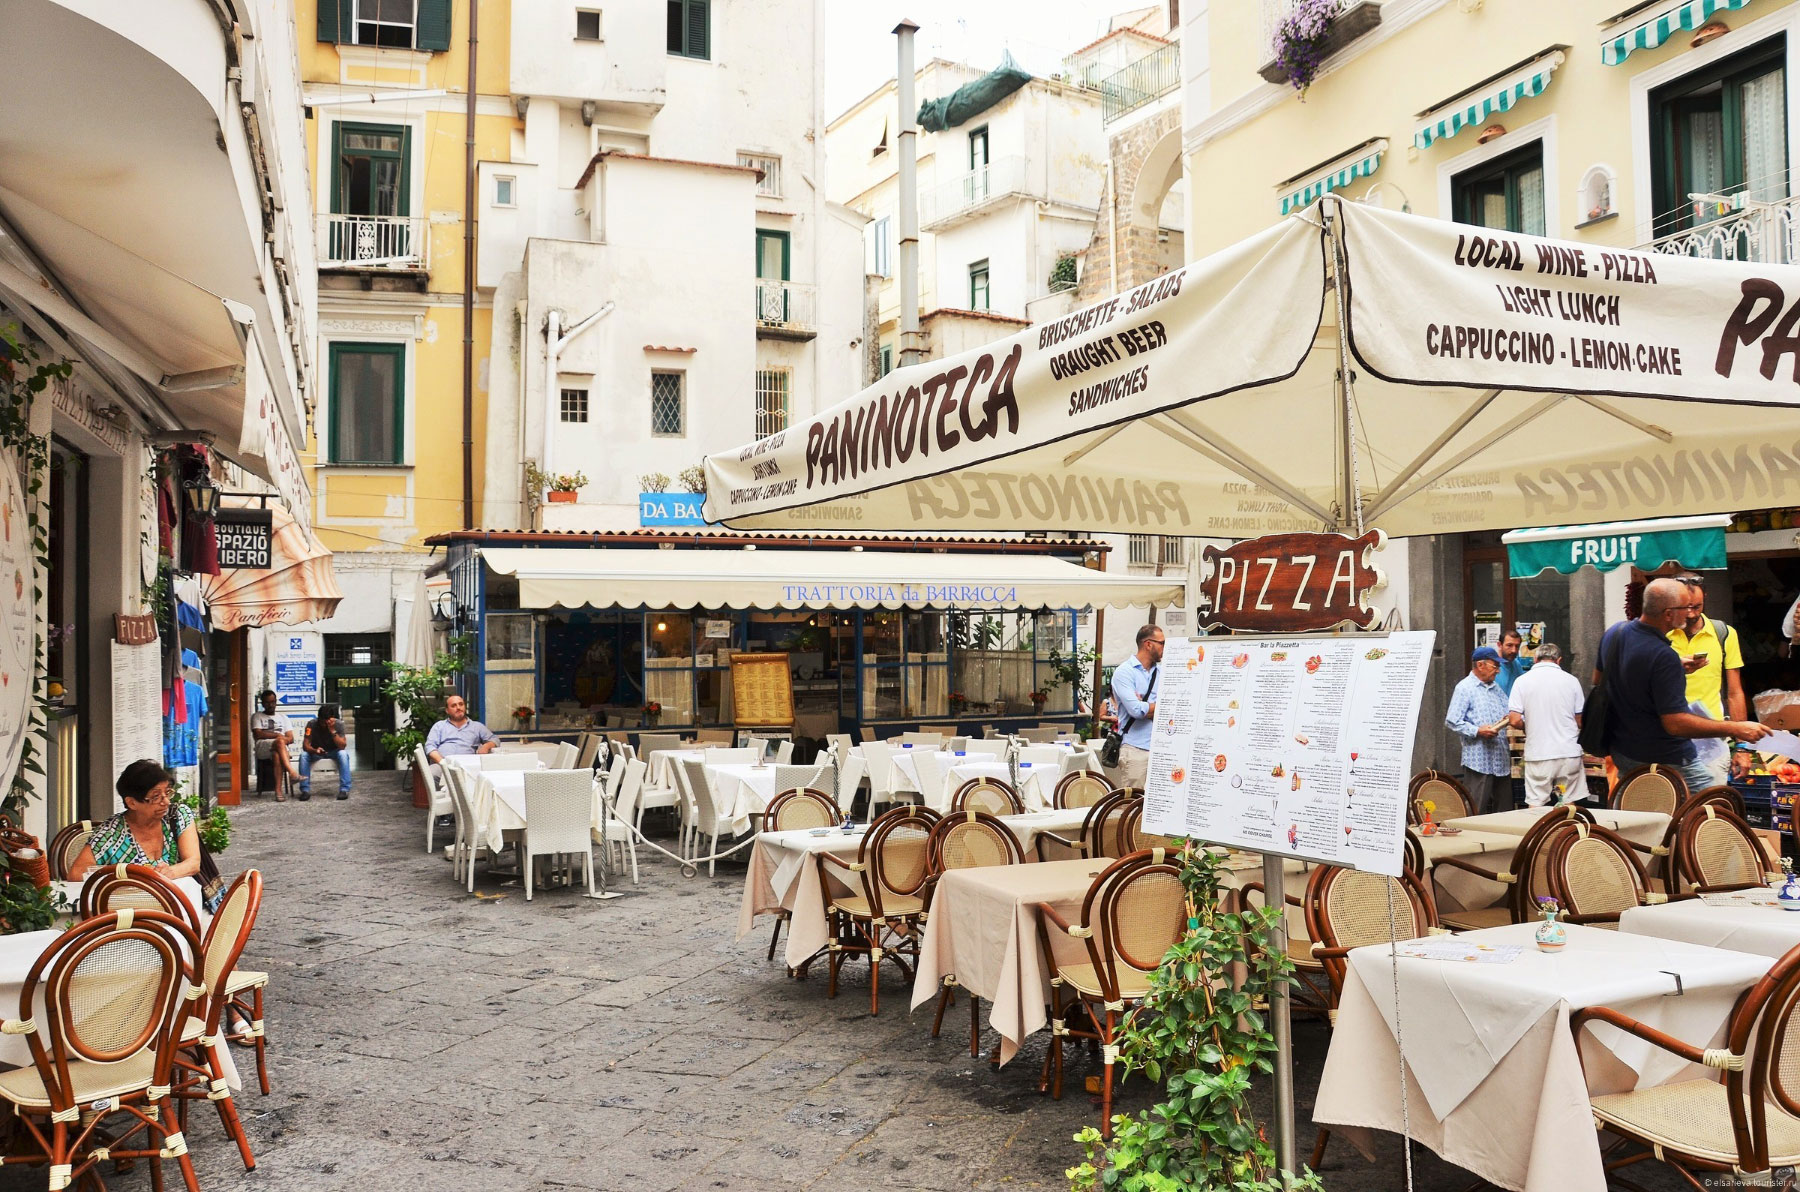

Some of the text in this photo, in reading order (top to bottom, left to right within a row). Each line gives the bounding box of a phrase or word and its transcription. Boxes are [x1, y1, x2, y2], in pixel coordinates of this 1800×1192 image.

[1454, 234, 1525, 271] LOCAL
[1535, 244, 1588, 278] WINE
[1602, 252, 1657, 284] PIZZA
[1038, 298, 1120, 350] BRUSCHETTE
[1126, 270, 1187, 315] SALADS
[1496, 284, 1620, 326] LIGHT LUNCH
[1050, 320, 1168, 381] DRAUGHT BEER
[1426, 323, 1555, 365] CAPPUCCINO
[1068, 365, 1149, 416] SANDWICHES
[806, 343, 1022, 490] PANINOTECA
[214, 525, 267, 535] BOUTIQUE
[643, 502, 669, 518] DA
[217, 550, 268, 565] IBERO
[1571, 535, 1641, 564] FRUIT
[783, 585, 1017, 602] TRATTORIA da BARRACCA
[1214, 550, 1356, 613] PIZZA
[120, 619, 154, 640] PIZZA
[222, 603, 291, 625] Panificio
